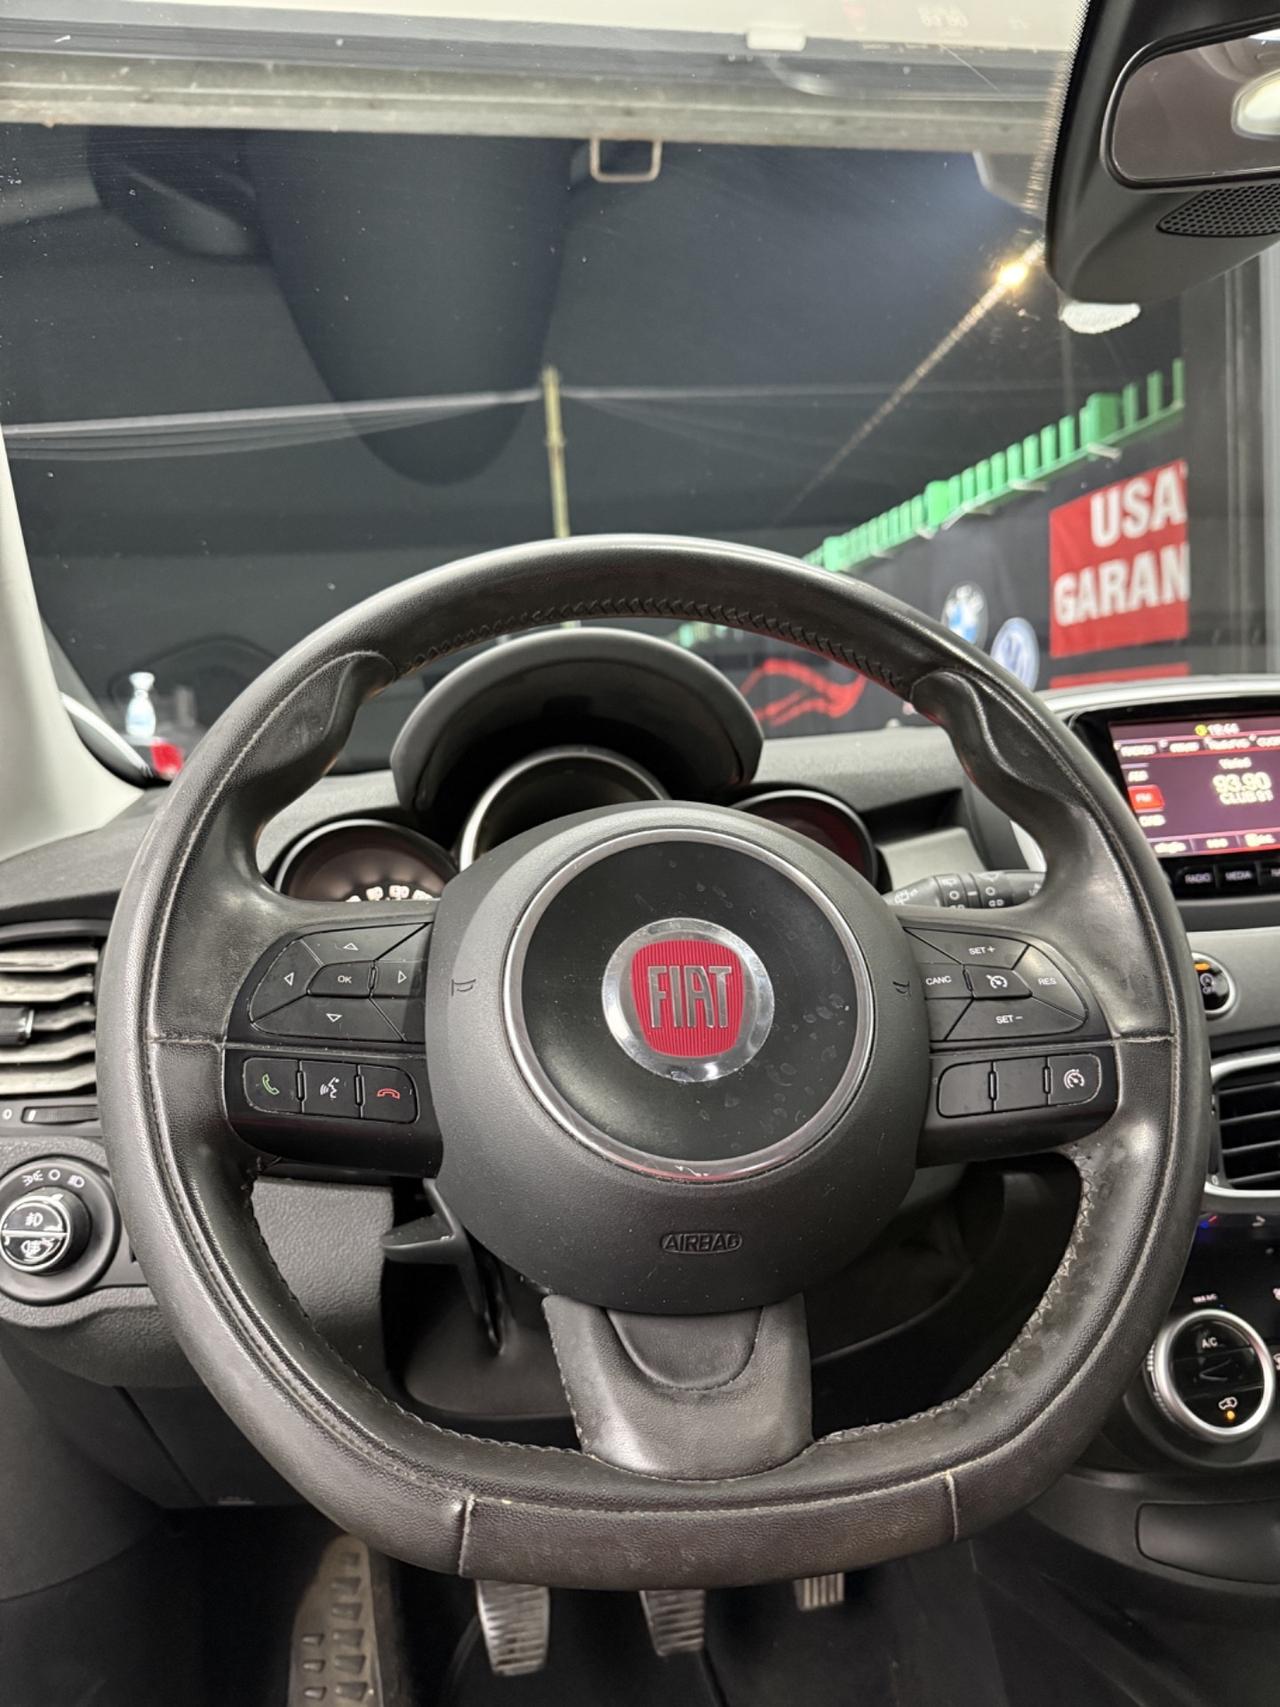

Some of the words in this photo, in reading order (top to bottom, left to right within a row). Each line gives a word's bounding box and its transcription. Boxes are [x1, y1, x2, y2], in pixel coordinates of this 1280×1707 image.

[1054, 541, 1190, 627] GARAN
[337, 975, 352, 984] OK
[925, 975, 952, 986] CANC
[1038, 976, 1057, 986] RES
[647, 964, 732, 1029] FIAT
[664, 1234, 739, 1251] AIRBAG
[1201, 1336, 1218, 1348] A/C
